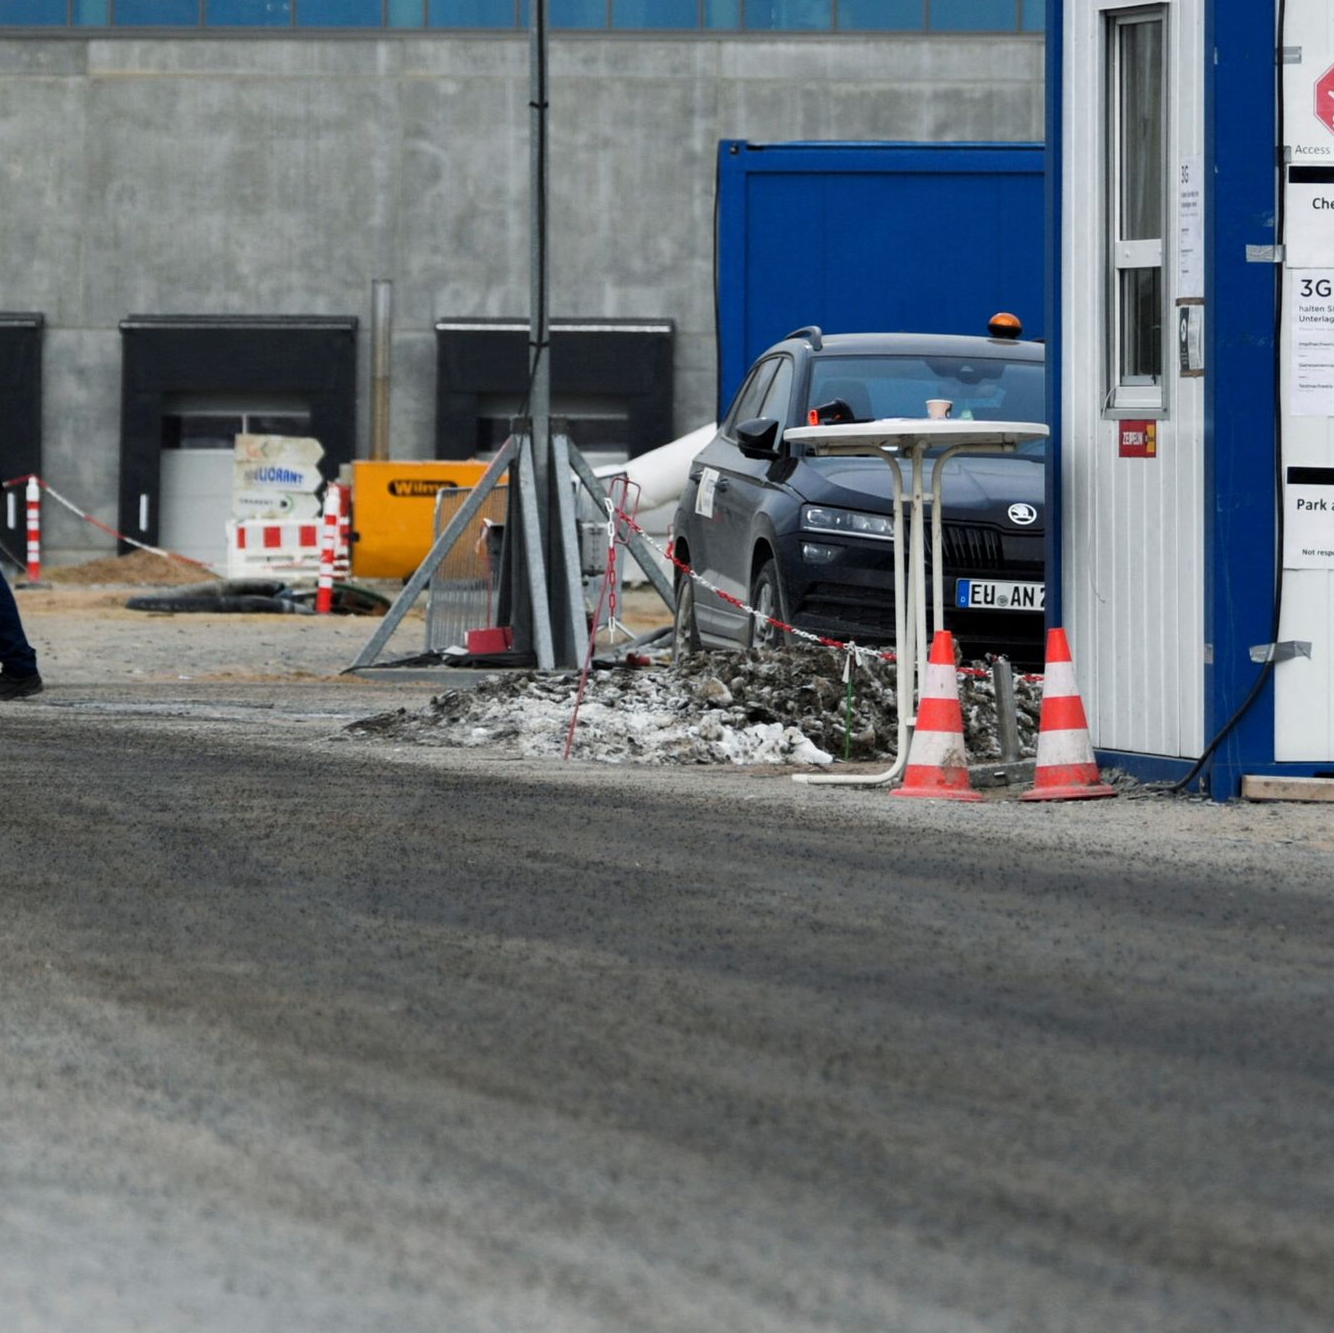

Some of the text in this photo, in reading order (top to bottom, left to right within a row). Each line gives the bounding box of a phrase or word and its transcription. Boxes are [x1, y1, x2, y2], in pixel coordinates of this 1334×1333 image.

[1295, 145, 1330, 155] Access
[1300, 279, 1332, 297] 3G
[1299, 305, 1325, 313] halten
[1297, 499, 1327, 511] Park
[971, 583, 996, 605] EU
[1010, 586, 1034, 607] AN
